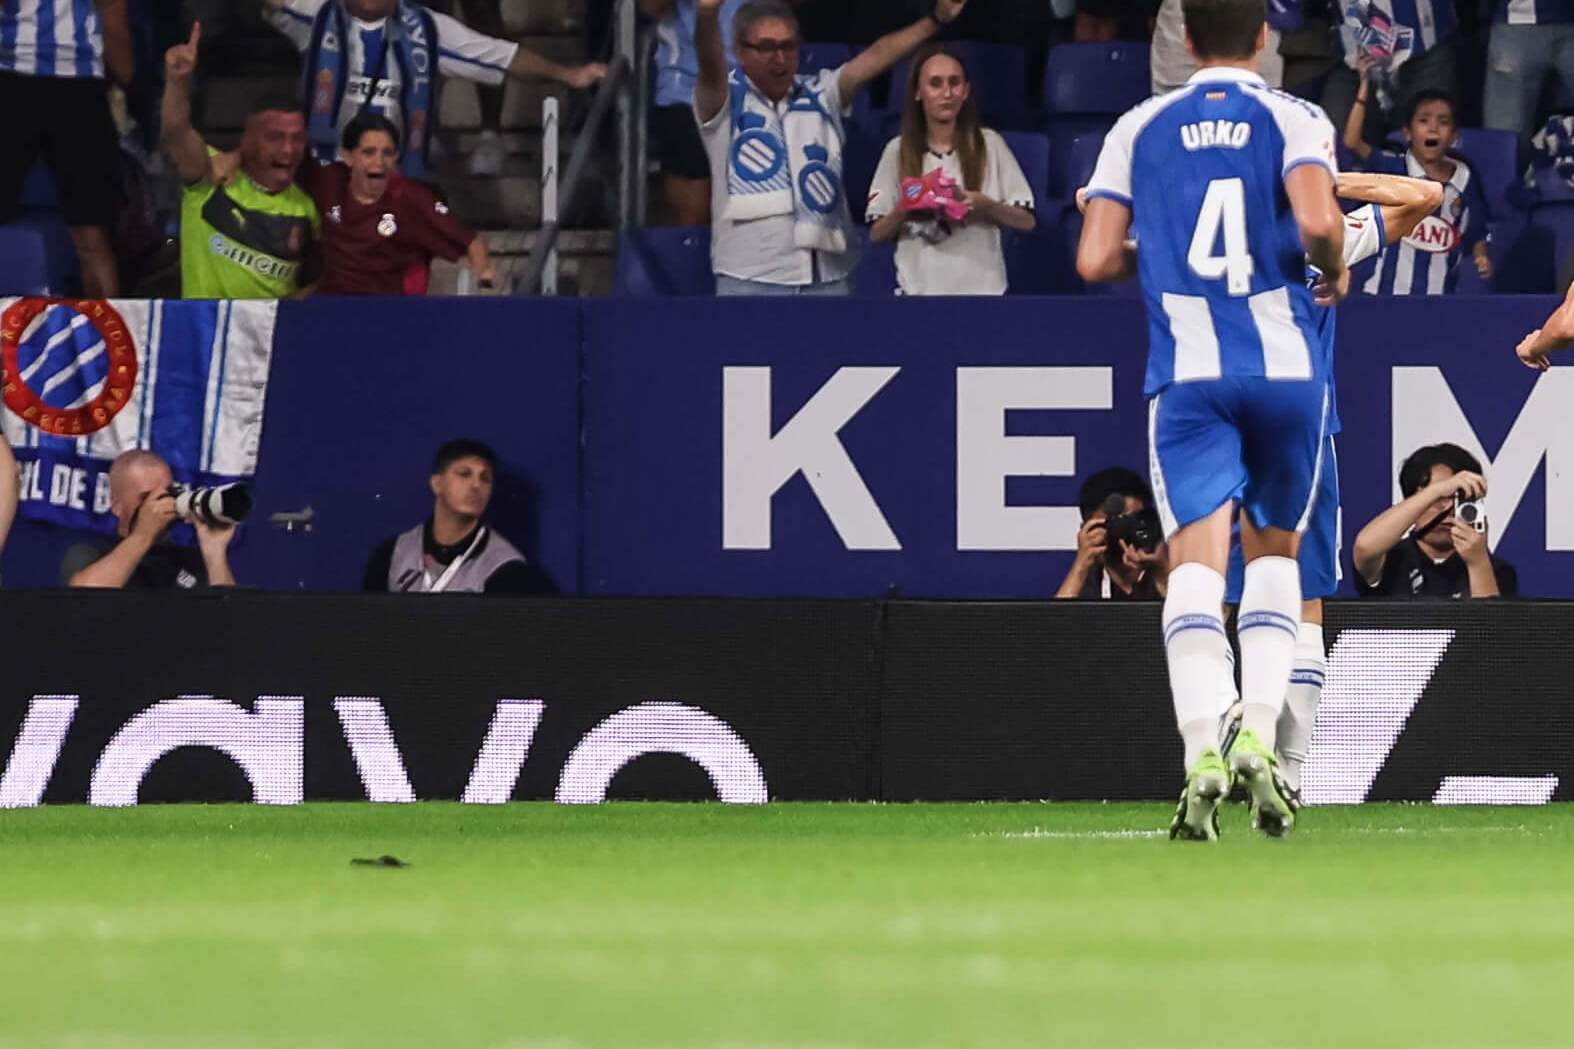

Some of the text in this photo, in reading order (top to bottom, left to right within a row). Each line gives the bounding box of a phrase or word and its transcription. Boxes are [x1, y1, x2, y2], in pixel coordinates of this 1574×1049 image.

[1180, 119, 1251, 151] URKO
[1187, 176, 1255, 297] 4
[1413, 223, 1450, 247] ANI
[50, 463, 87, 510] DE
